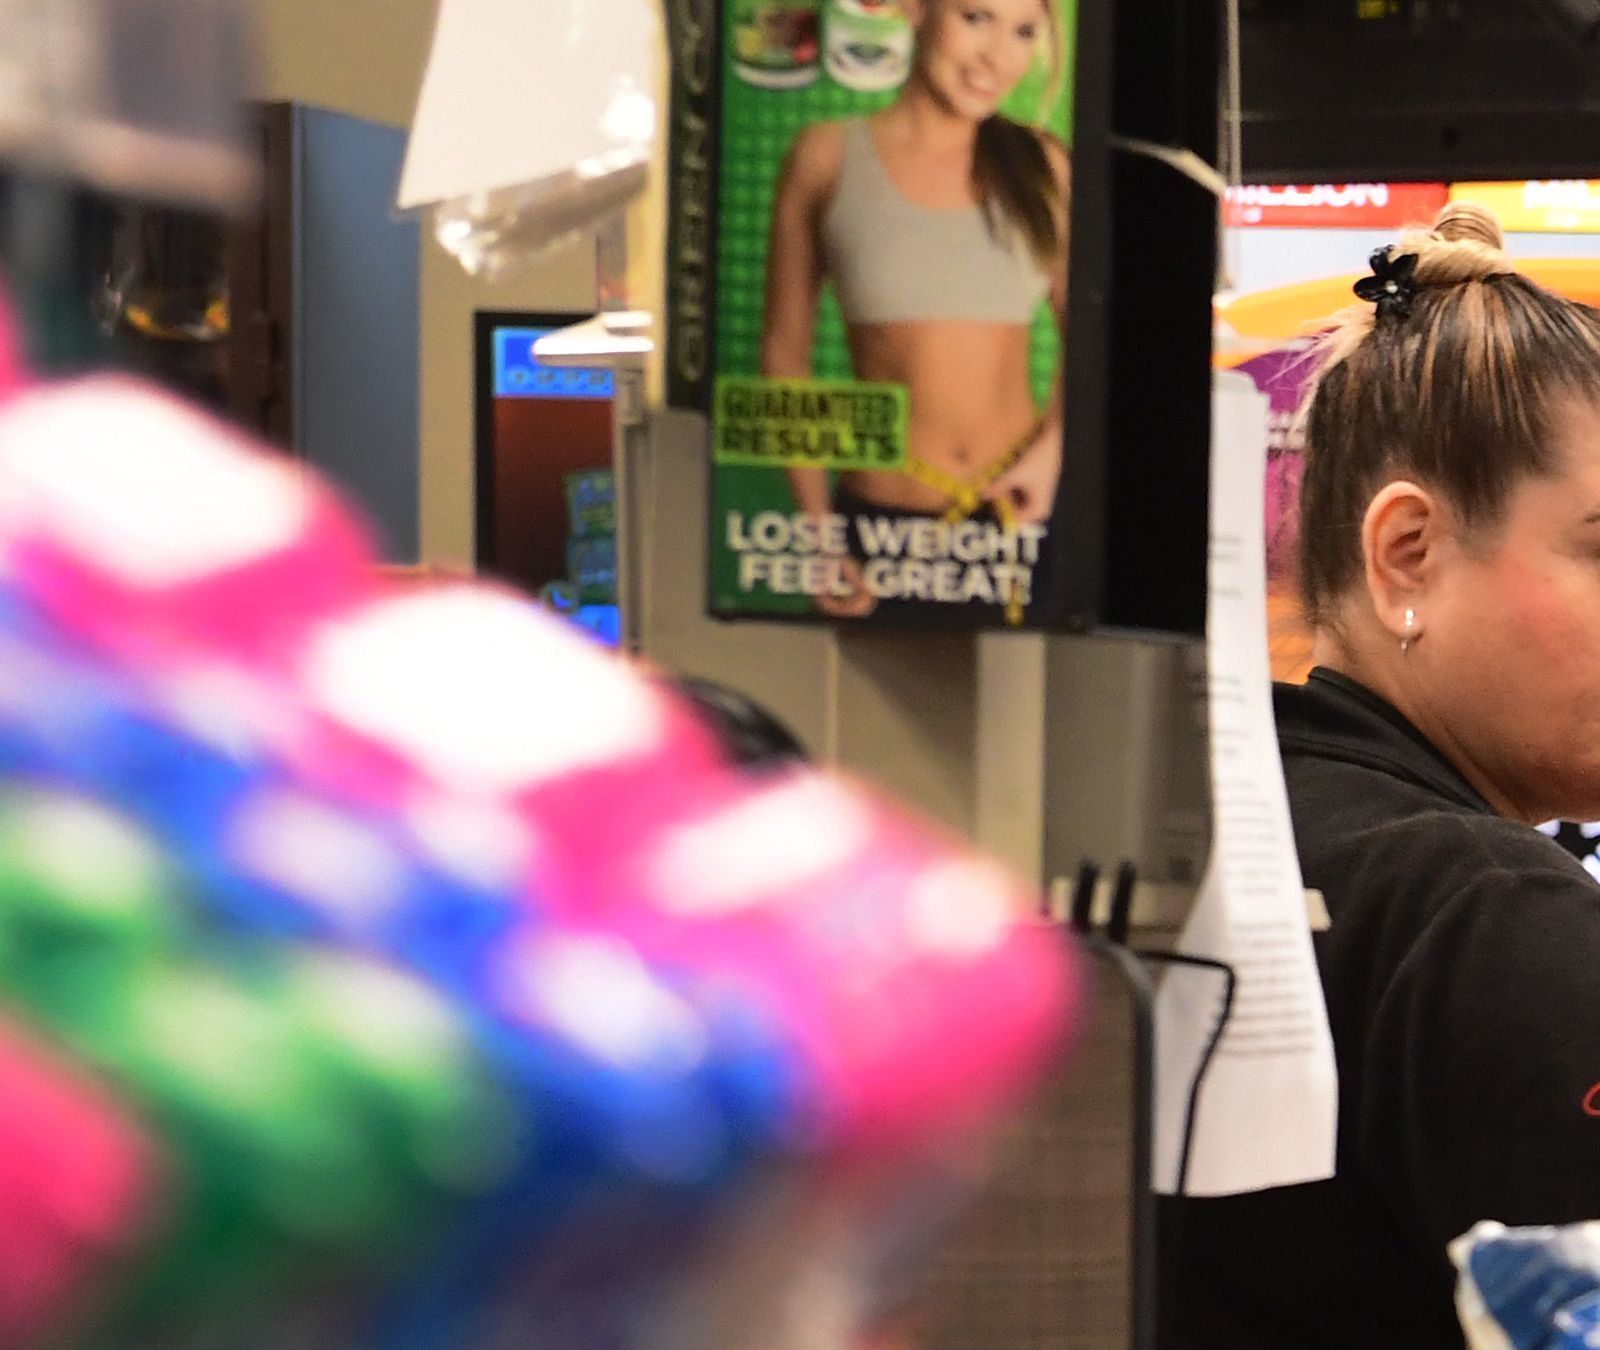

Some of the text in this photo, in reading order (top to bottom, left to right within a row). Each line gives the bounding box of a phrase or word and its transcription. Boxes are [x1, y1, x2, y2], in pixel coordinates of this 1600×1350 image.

[722, 387, 897, 427] GUARANTEED
[721, 426, 899, 463] RESULTS
[726, 509, 1048, 563] LOSE WEIGHT
[738, 552, 1032, 605] FEEL GREAT!
